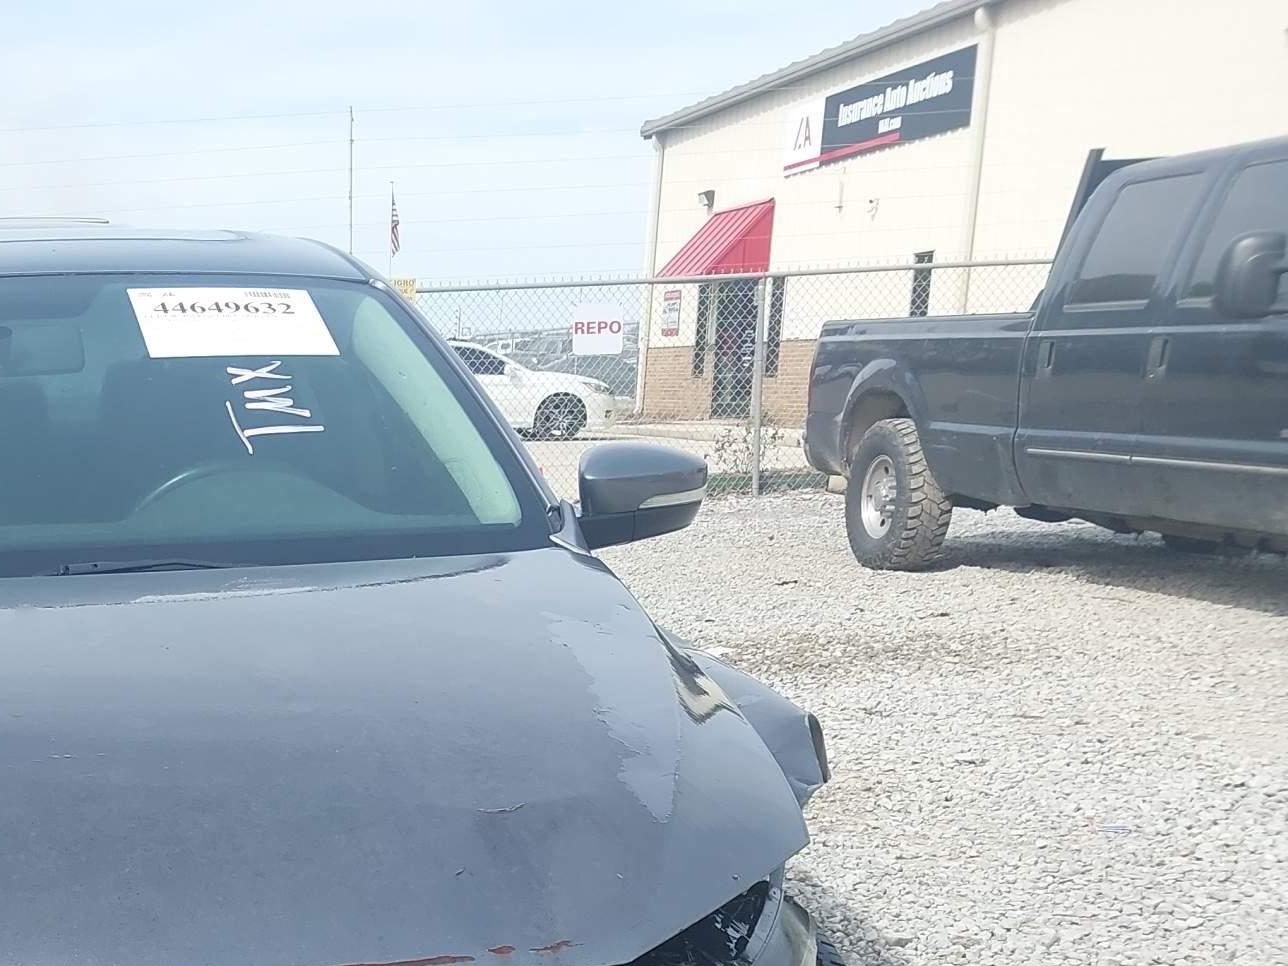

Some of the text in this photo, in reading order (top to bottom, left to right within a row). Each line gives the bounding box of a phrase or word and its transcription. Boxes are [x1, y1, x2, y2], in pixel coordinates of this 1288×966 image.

[838, 70, 953, 127] Insurance Auto Auctions
[153, 301, 295, 315] 44649632
[574, 320, 621, 334] REPO
